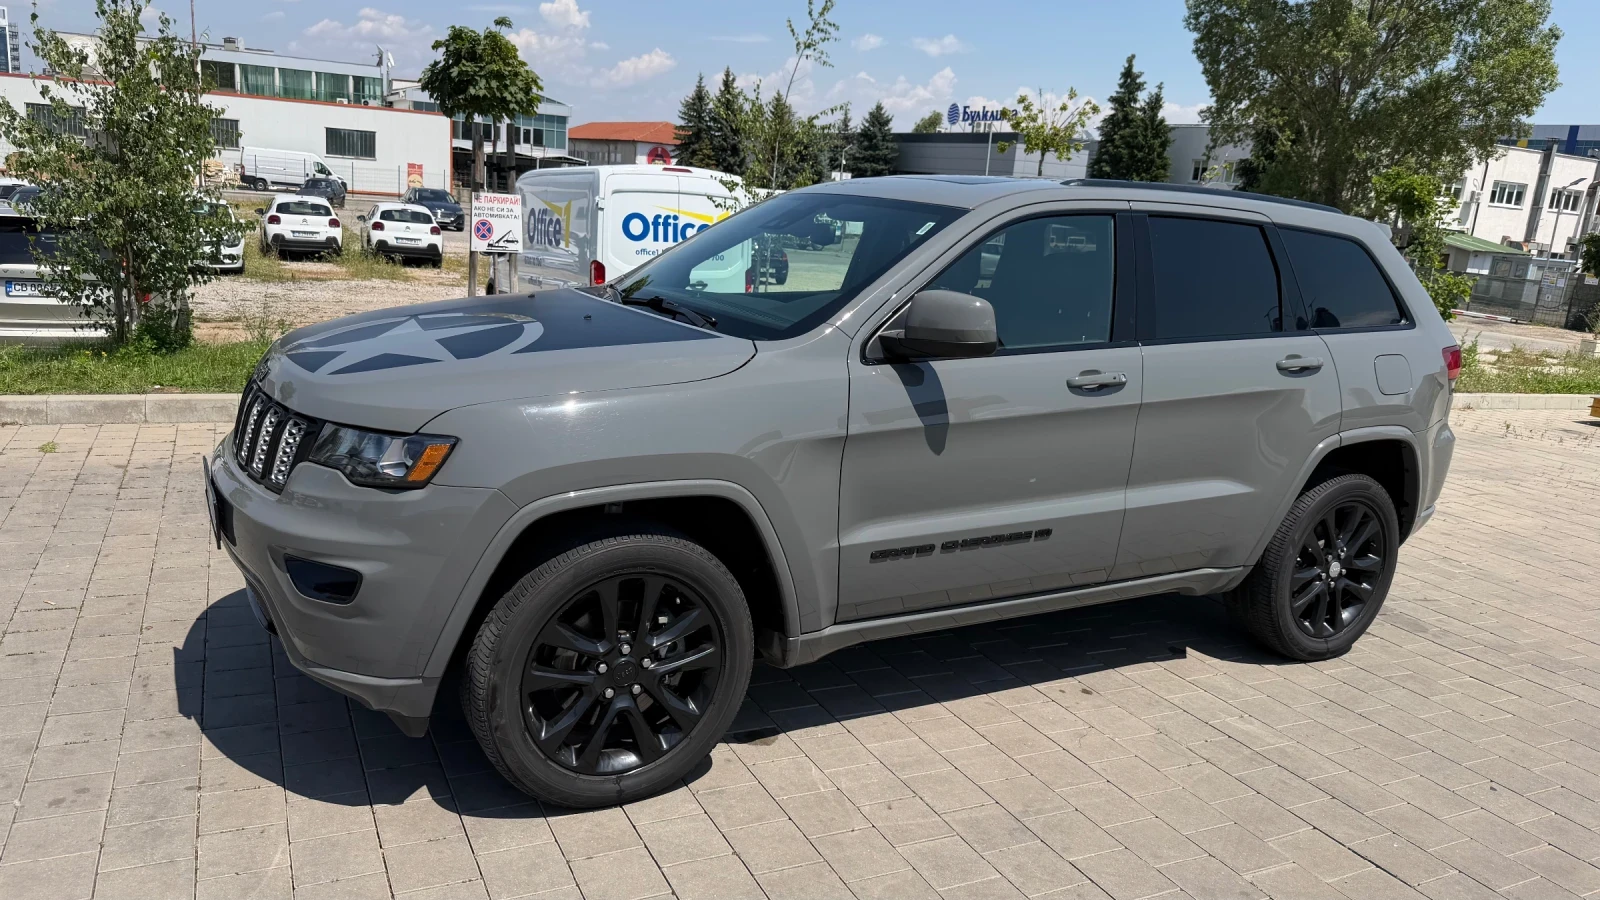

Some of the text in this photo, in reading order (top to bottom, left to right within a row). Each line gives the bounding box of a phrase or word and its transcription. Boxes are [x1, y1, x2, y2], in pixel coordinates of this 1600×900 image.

[962, 106, 1018, 126] Булклиа
[474, 194, 521, 206] НЕ ПАРКИРАЙ!
[474, 212, 520, 220] АВТОМИВКАТА!
[870, 543, 936, 560] GRAND
[941, 530, 1034, 551] CHEROKEE
